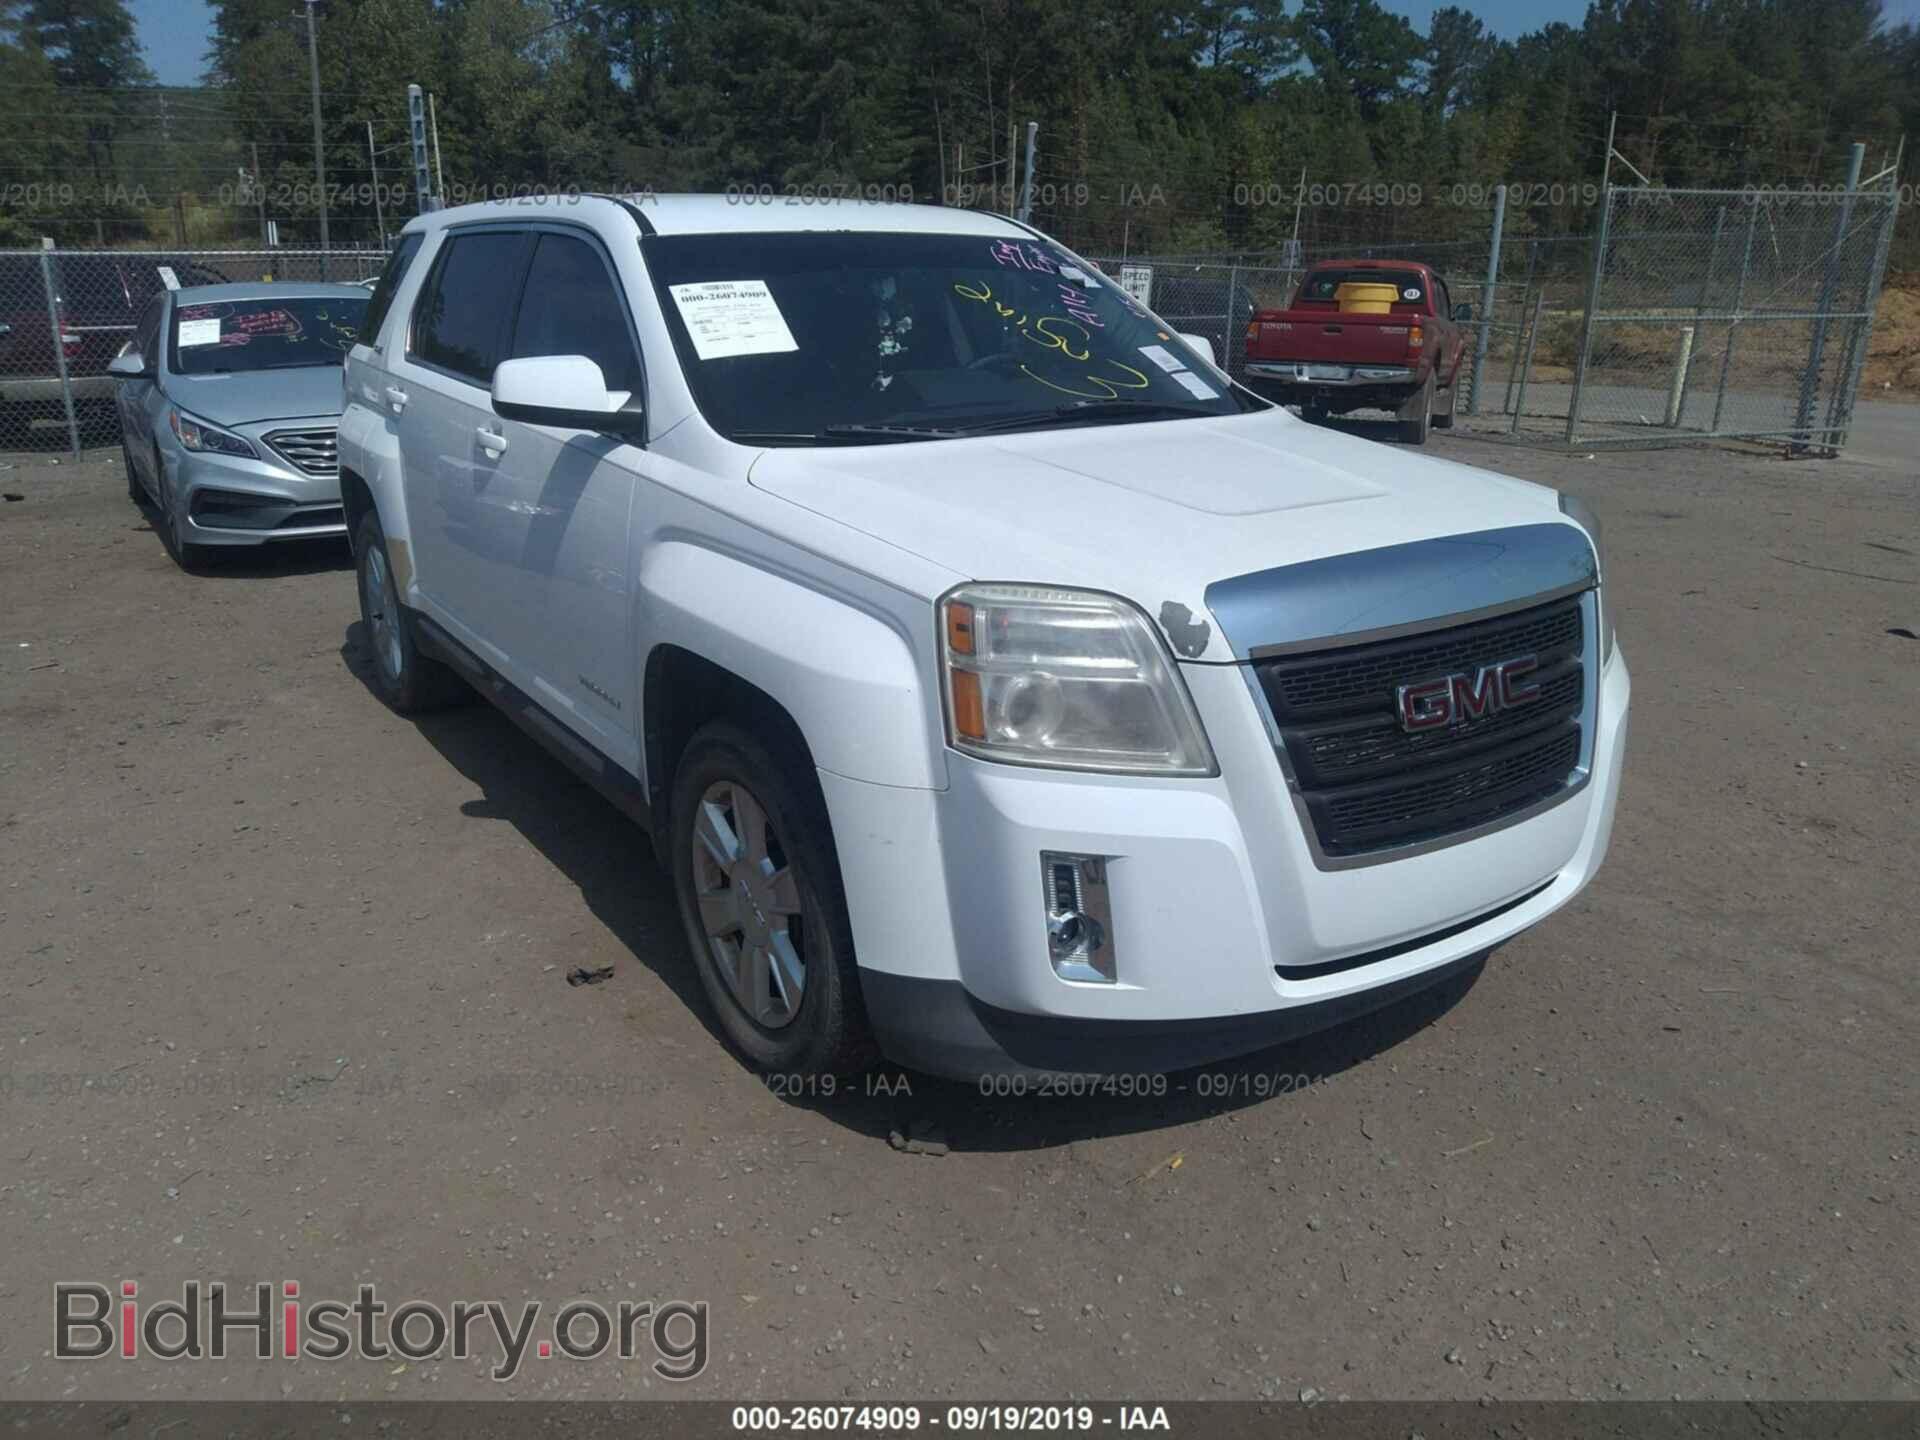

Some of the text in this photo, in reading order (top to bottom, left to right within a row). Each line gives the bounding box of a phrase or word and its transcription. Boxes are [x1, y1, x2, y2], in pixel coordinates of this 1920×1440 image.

[1123, 271, 1150, 281] SPEED
[1124, 283, 1147, 292] LIMIT
[1397, 653, 1541, 733] GMC
